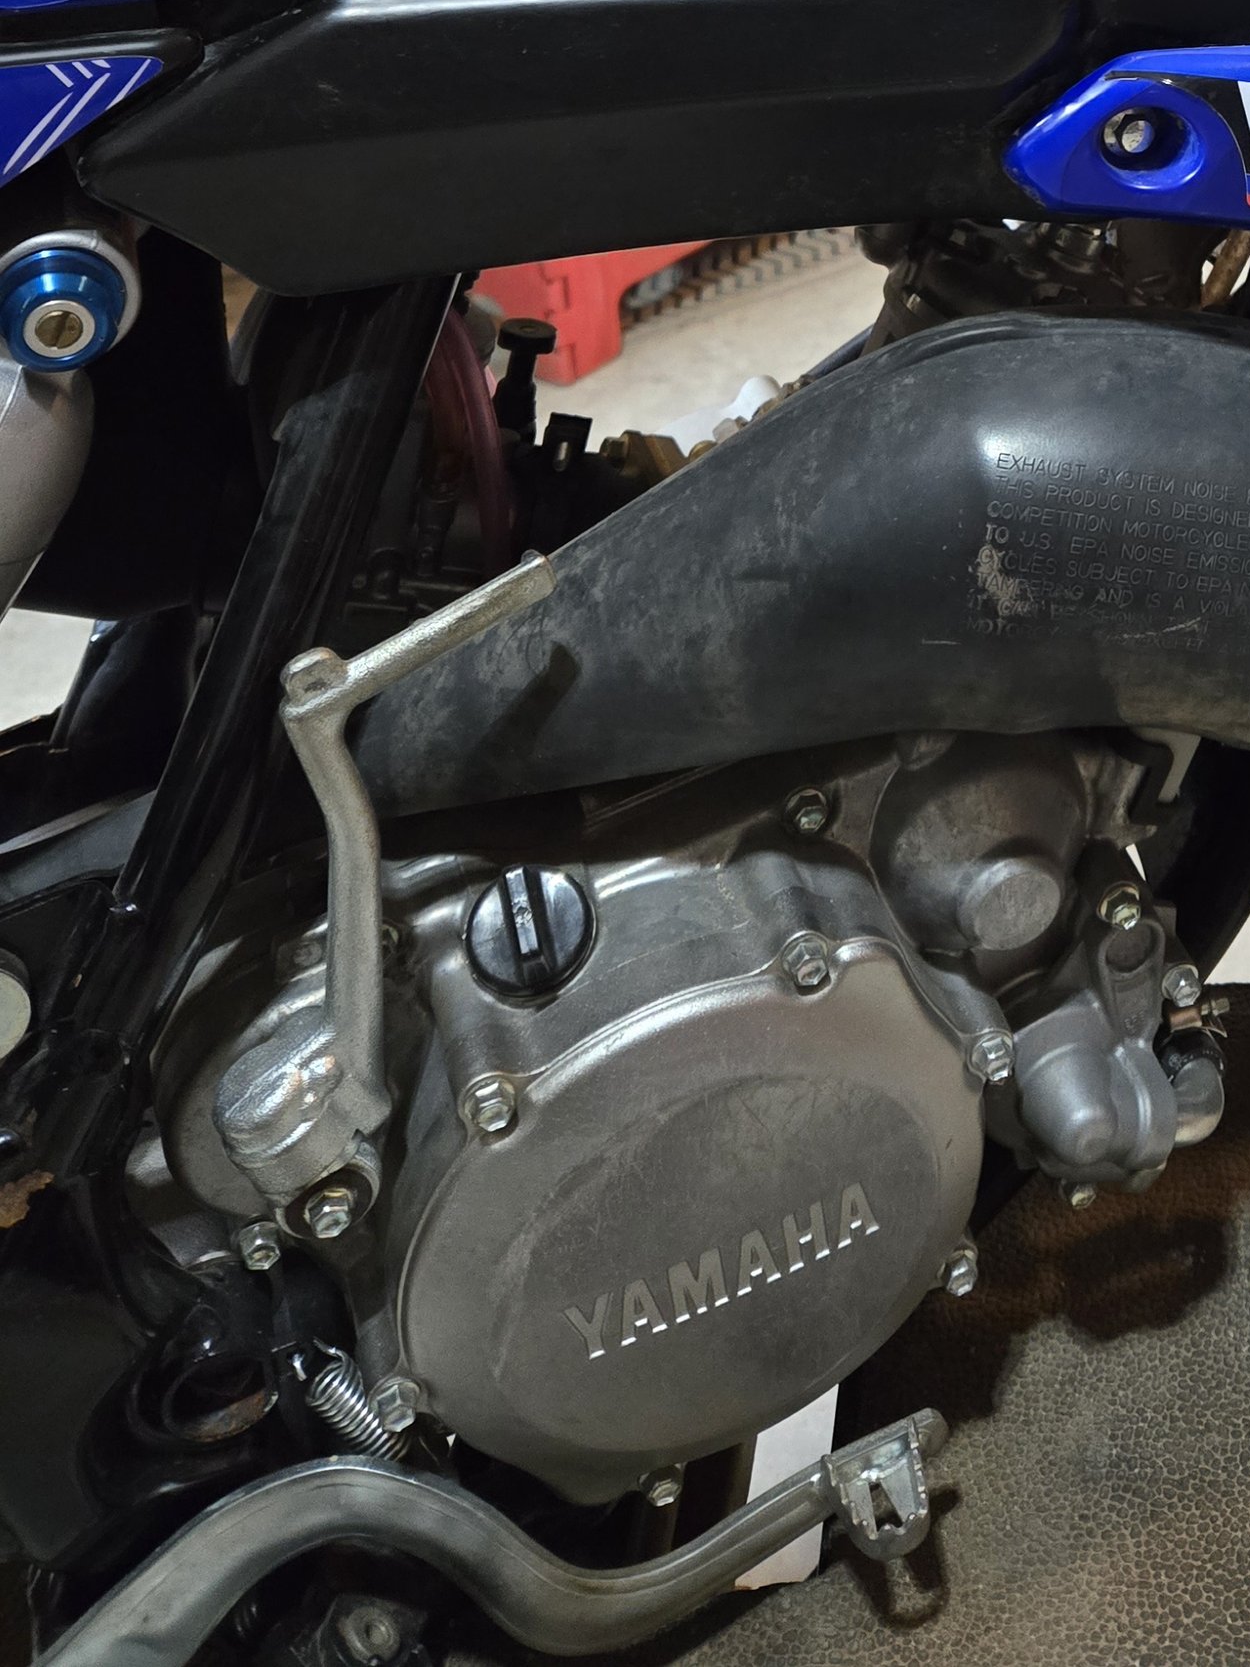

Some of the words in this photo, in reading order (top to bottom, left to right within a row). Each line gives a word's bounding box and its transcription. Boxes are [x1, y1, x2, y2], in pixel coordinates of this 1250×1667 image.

[994, 475, 1034, 499] THIS
[1045, 484, 1133, 512] PRODUCT
[1145, 498, 1161, 516] IS
[997, 452, 1086, 483] EXHAUST
[1098, 468, 1175, 494] SYSTEM
[1184, 481, 1237, 503] NOISE
[987, 500, 1112, 533] COMPETITION
[985, 522, 1010, 544] TO
[1070, 535, 1109, 558] EPA
[1121, 543, 1177, 566] NOISE
[1066, 559, 1153, 584] SUBJECT
[1166, 571, 1189, 590] TO
[1196, 574, 1232, 593] EPA
[1145, 592, 1161, 608] IS
[1173, 597, 1186, 611] A
[563, 1181, 880, 1360] YAMAHA
